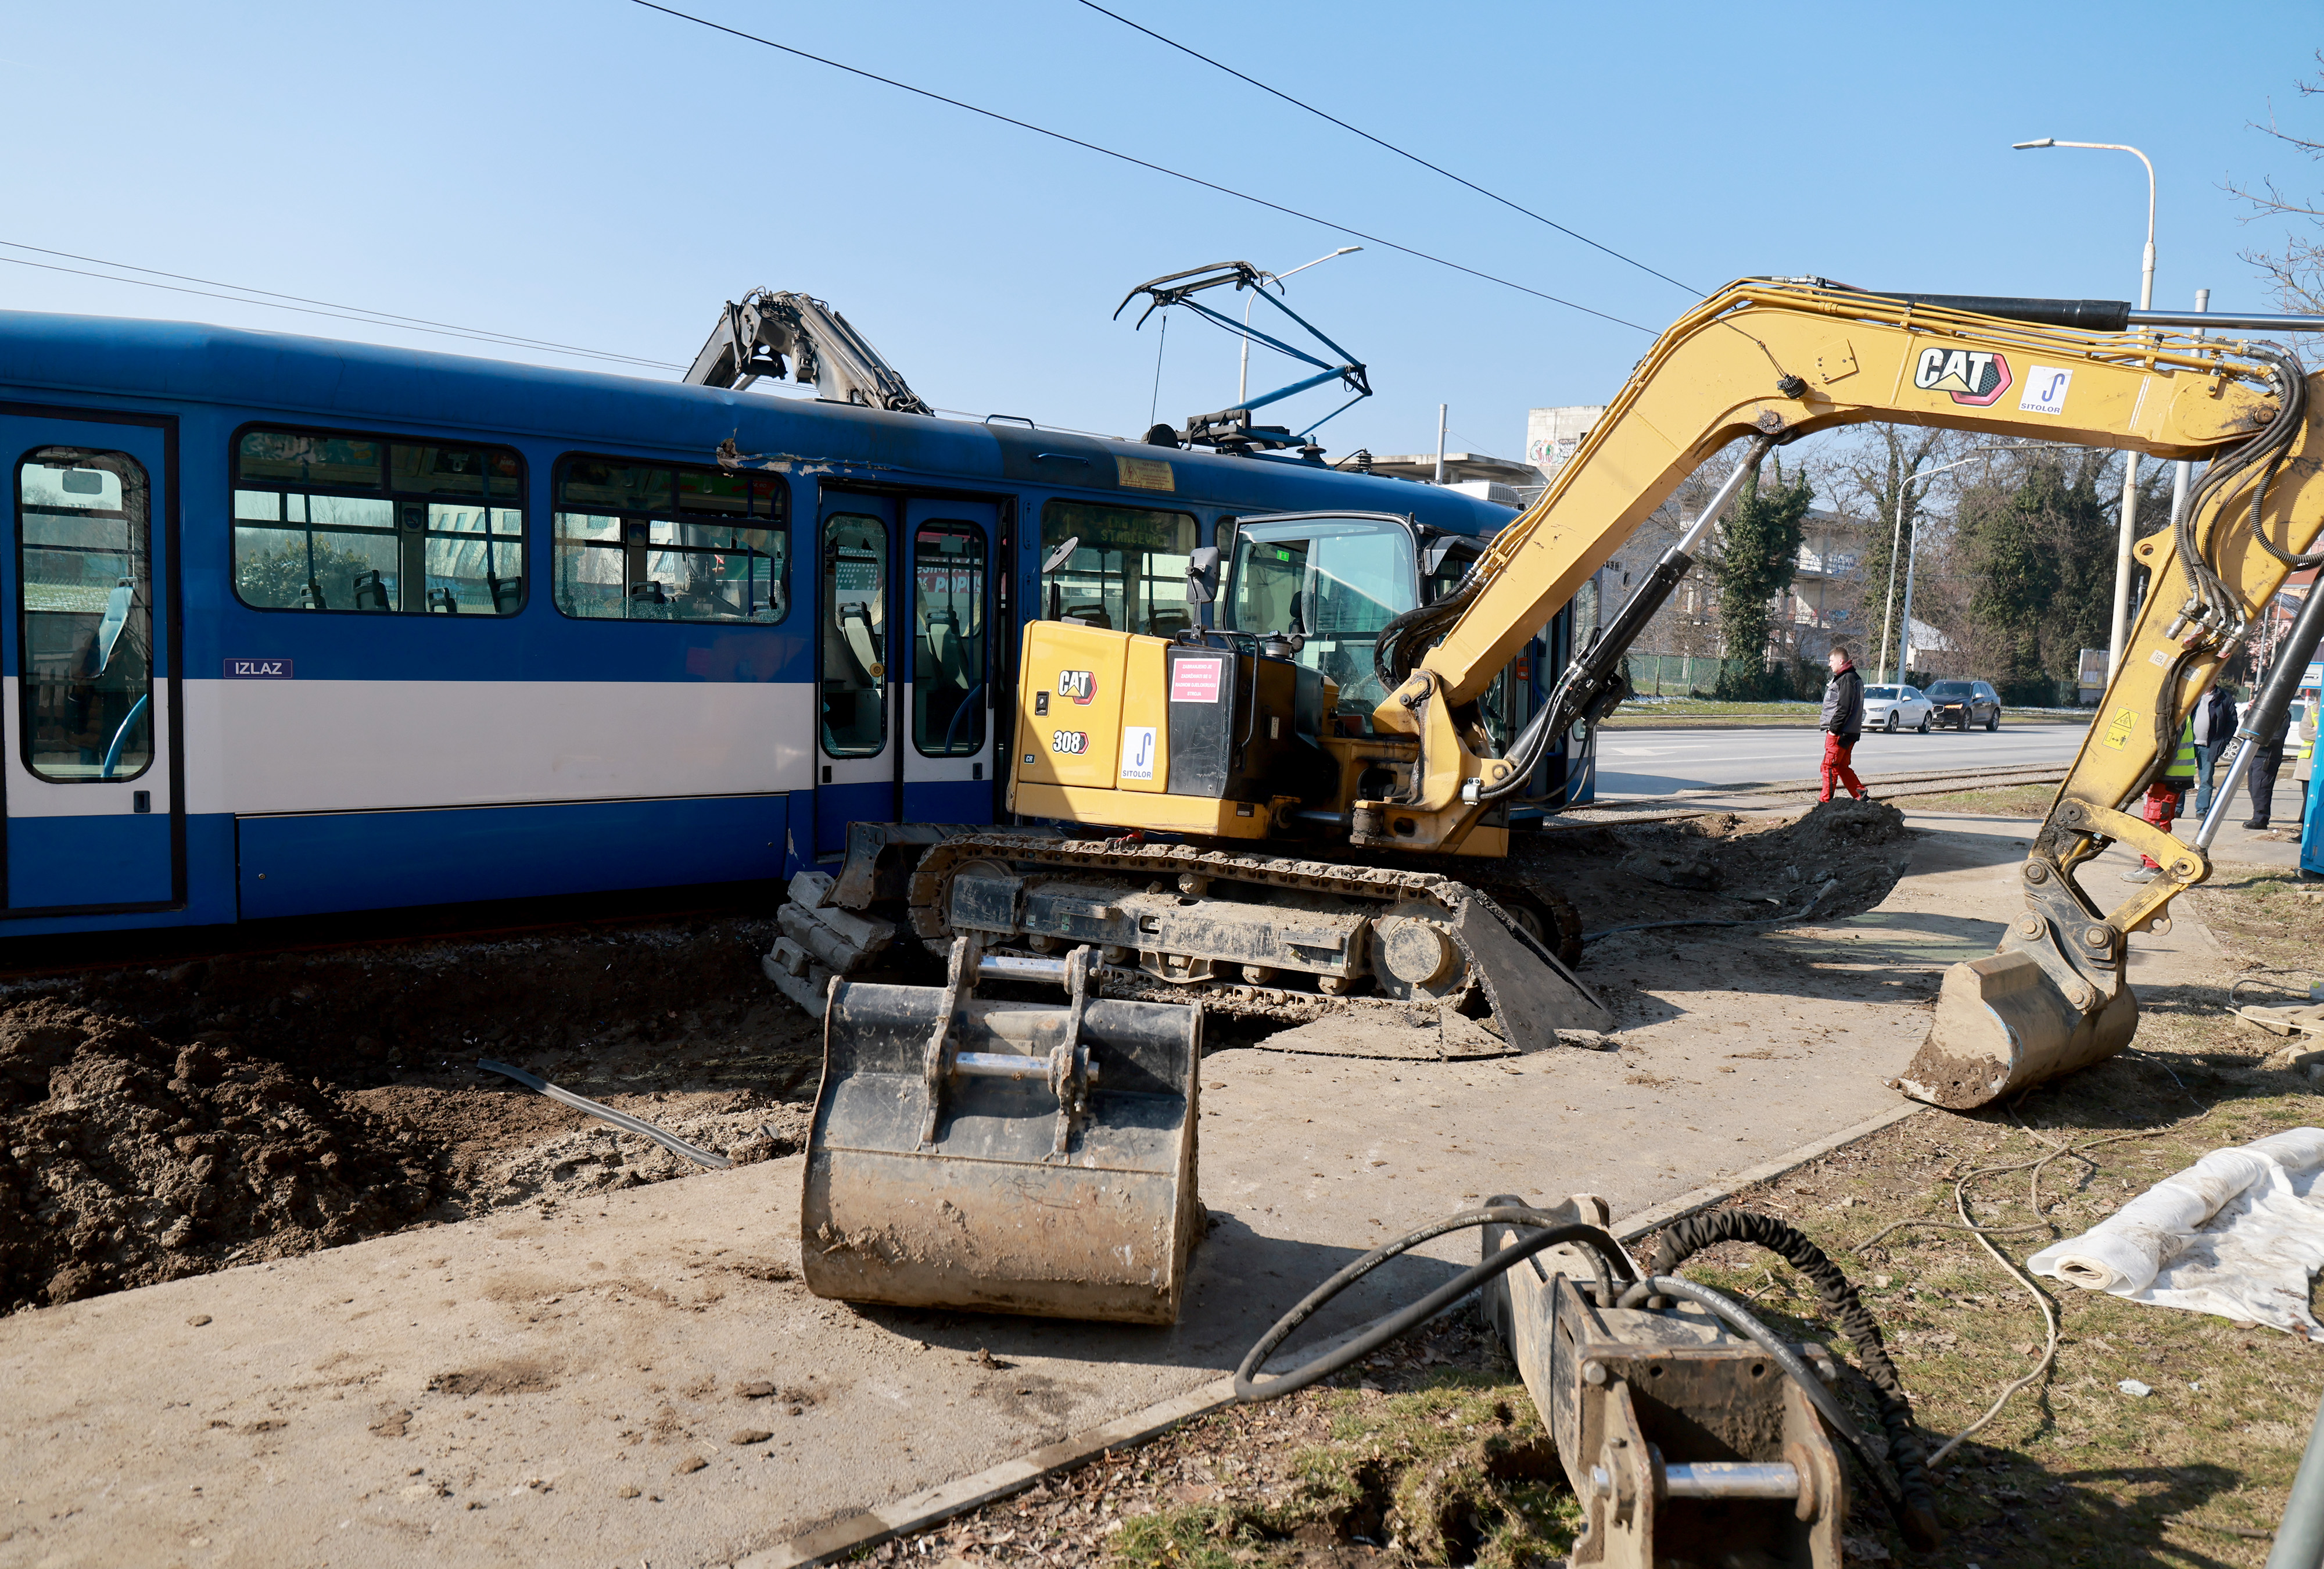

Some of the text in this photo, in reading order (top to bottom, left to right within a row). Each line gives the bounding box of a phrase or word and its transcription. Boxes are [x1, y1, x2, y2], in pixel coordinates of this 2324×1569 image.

[1916, 348, 1993, 392] CAT
[2021, 403, 2060, 414] SITOLOR
[235, 662, 282, 675] IZLAZ
[1059, 671, 1089, 697] CAT
[1053, 731, 1081, 754] 308
[1122, 770, 1152, 779] SITOLOR
